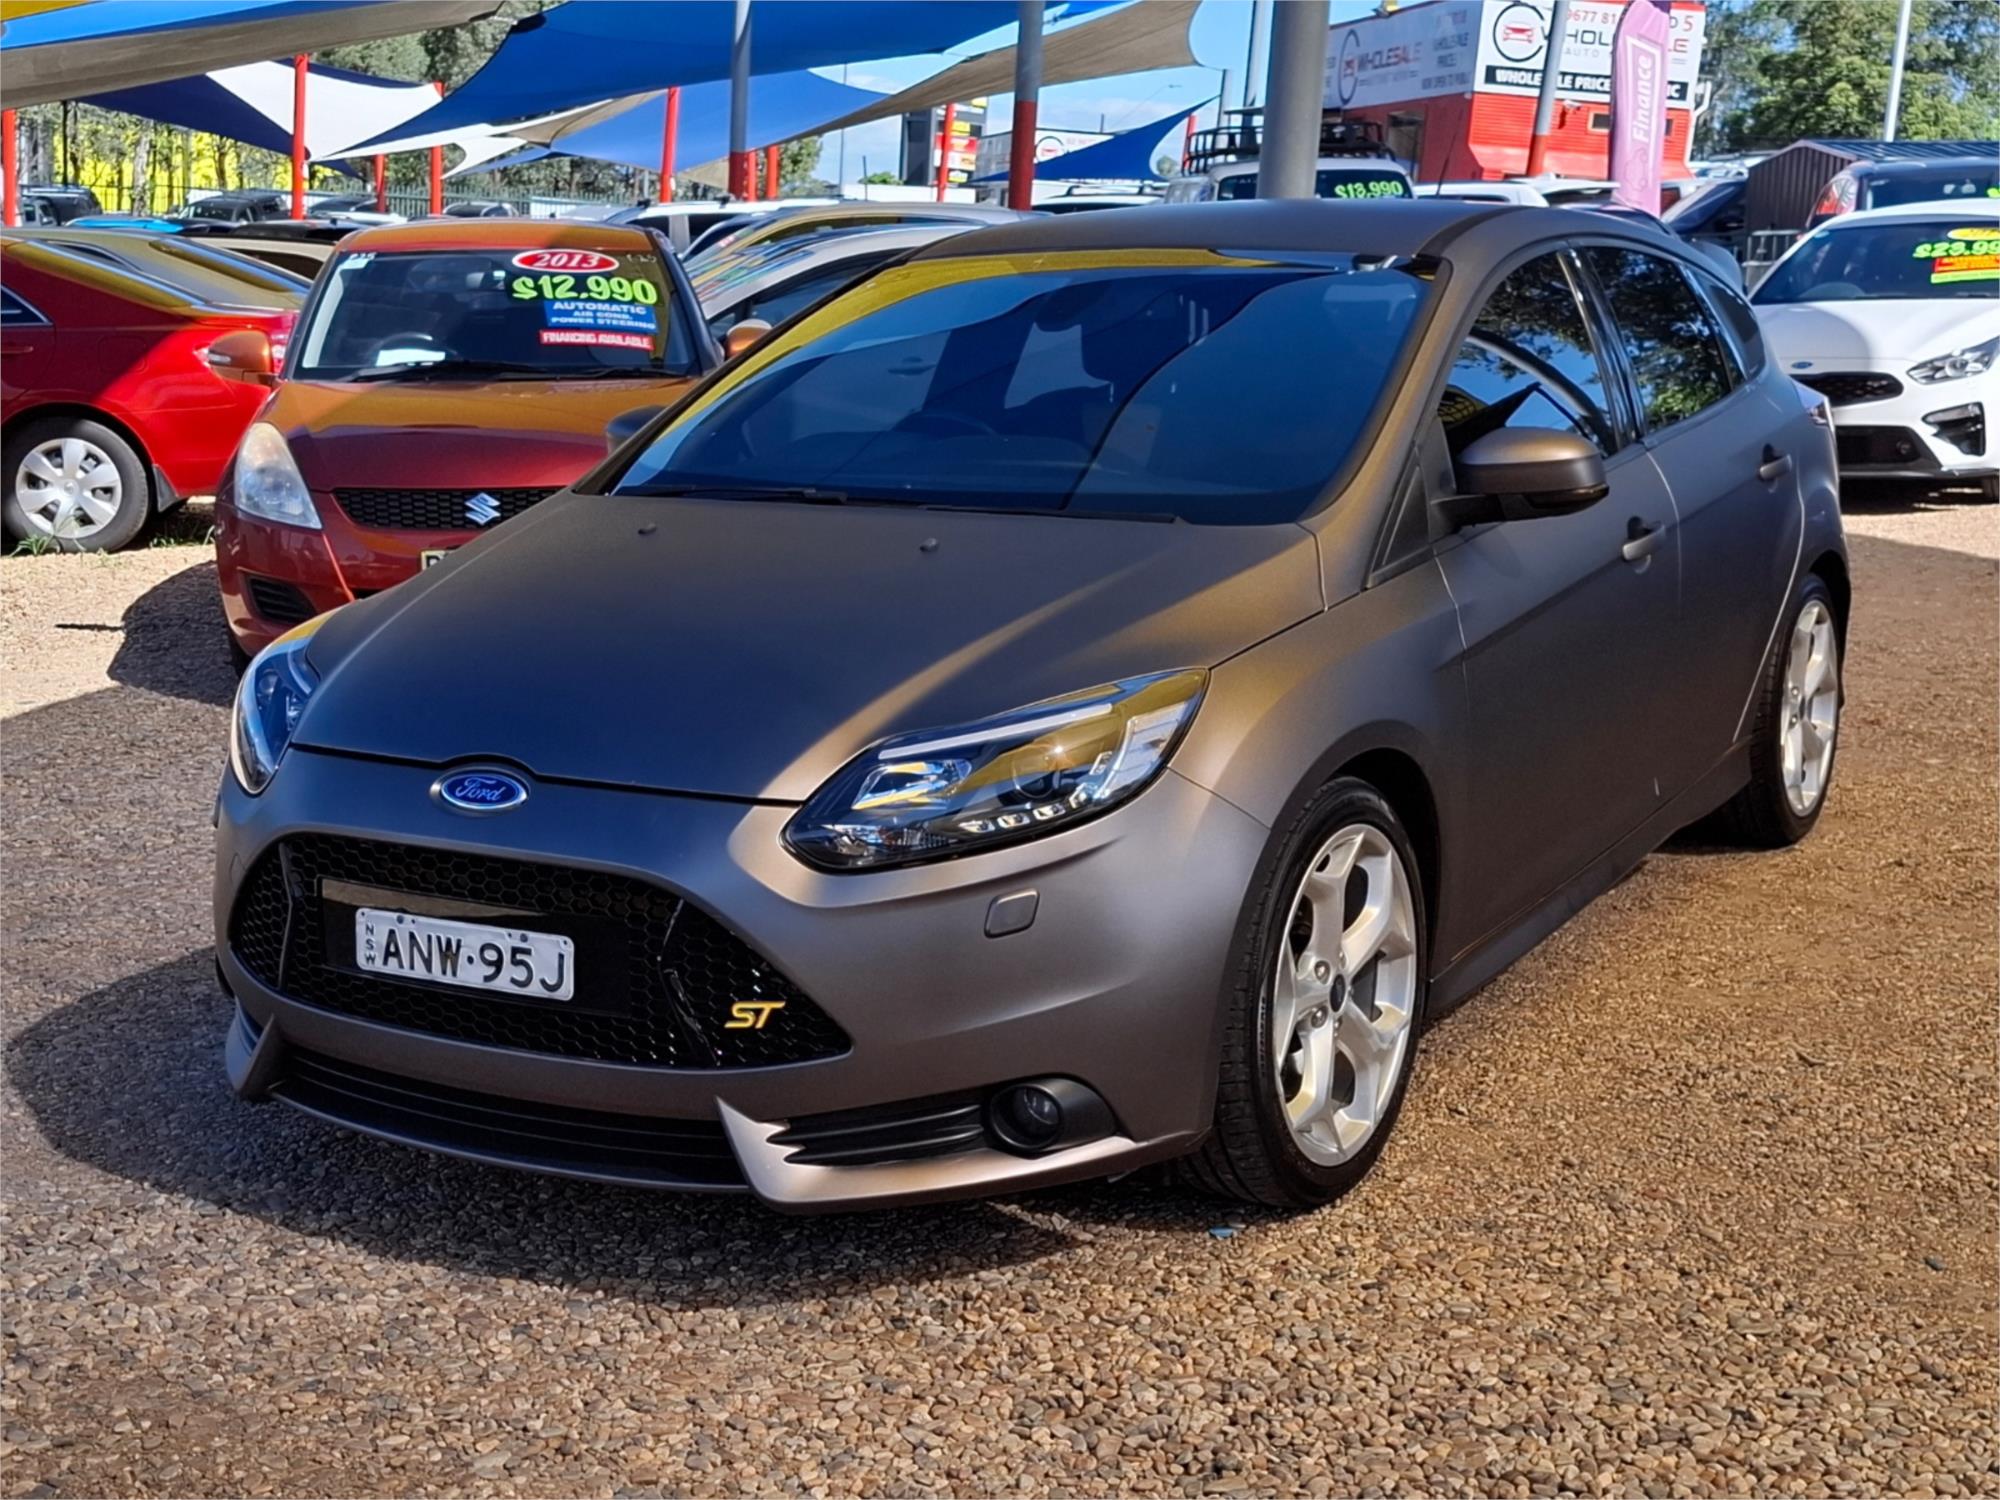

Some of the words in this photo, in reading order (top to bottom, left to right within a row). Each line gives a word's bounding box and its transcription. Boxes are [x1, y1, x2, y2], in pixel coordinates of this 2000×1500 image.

[1631, 54, 1654, 143] Finance
[532, 252, 600, 268] 2013
[552, 301, 647, 316] AUTOMATIC
[551, 317, 595, 325] POWER
[596, 317, 656, 330] STEERING
[455, 776, 507, 801] Ford
[724, 1001, 786, 1029] ST
